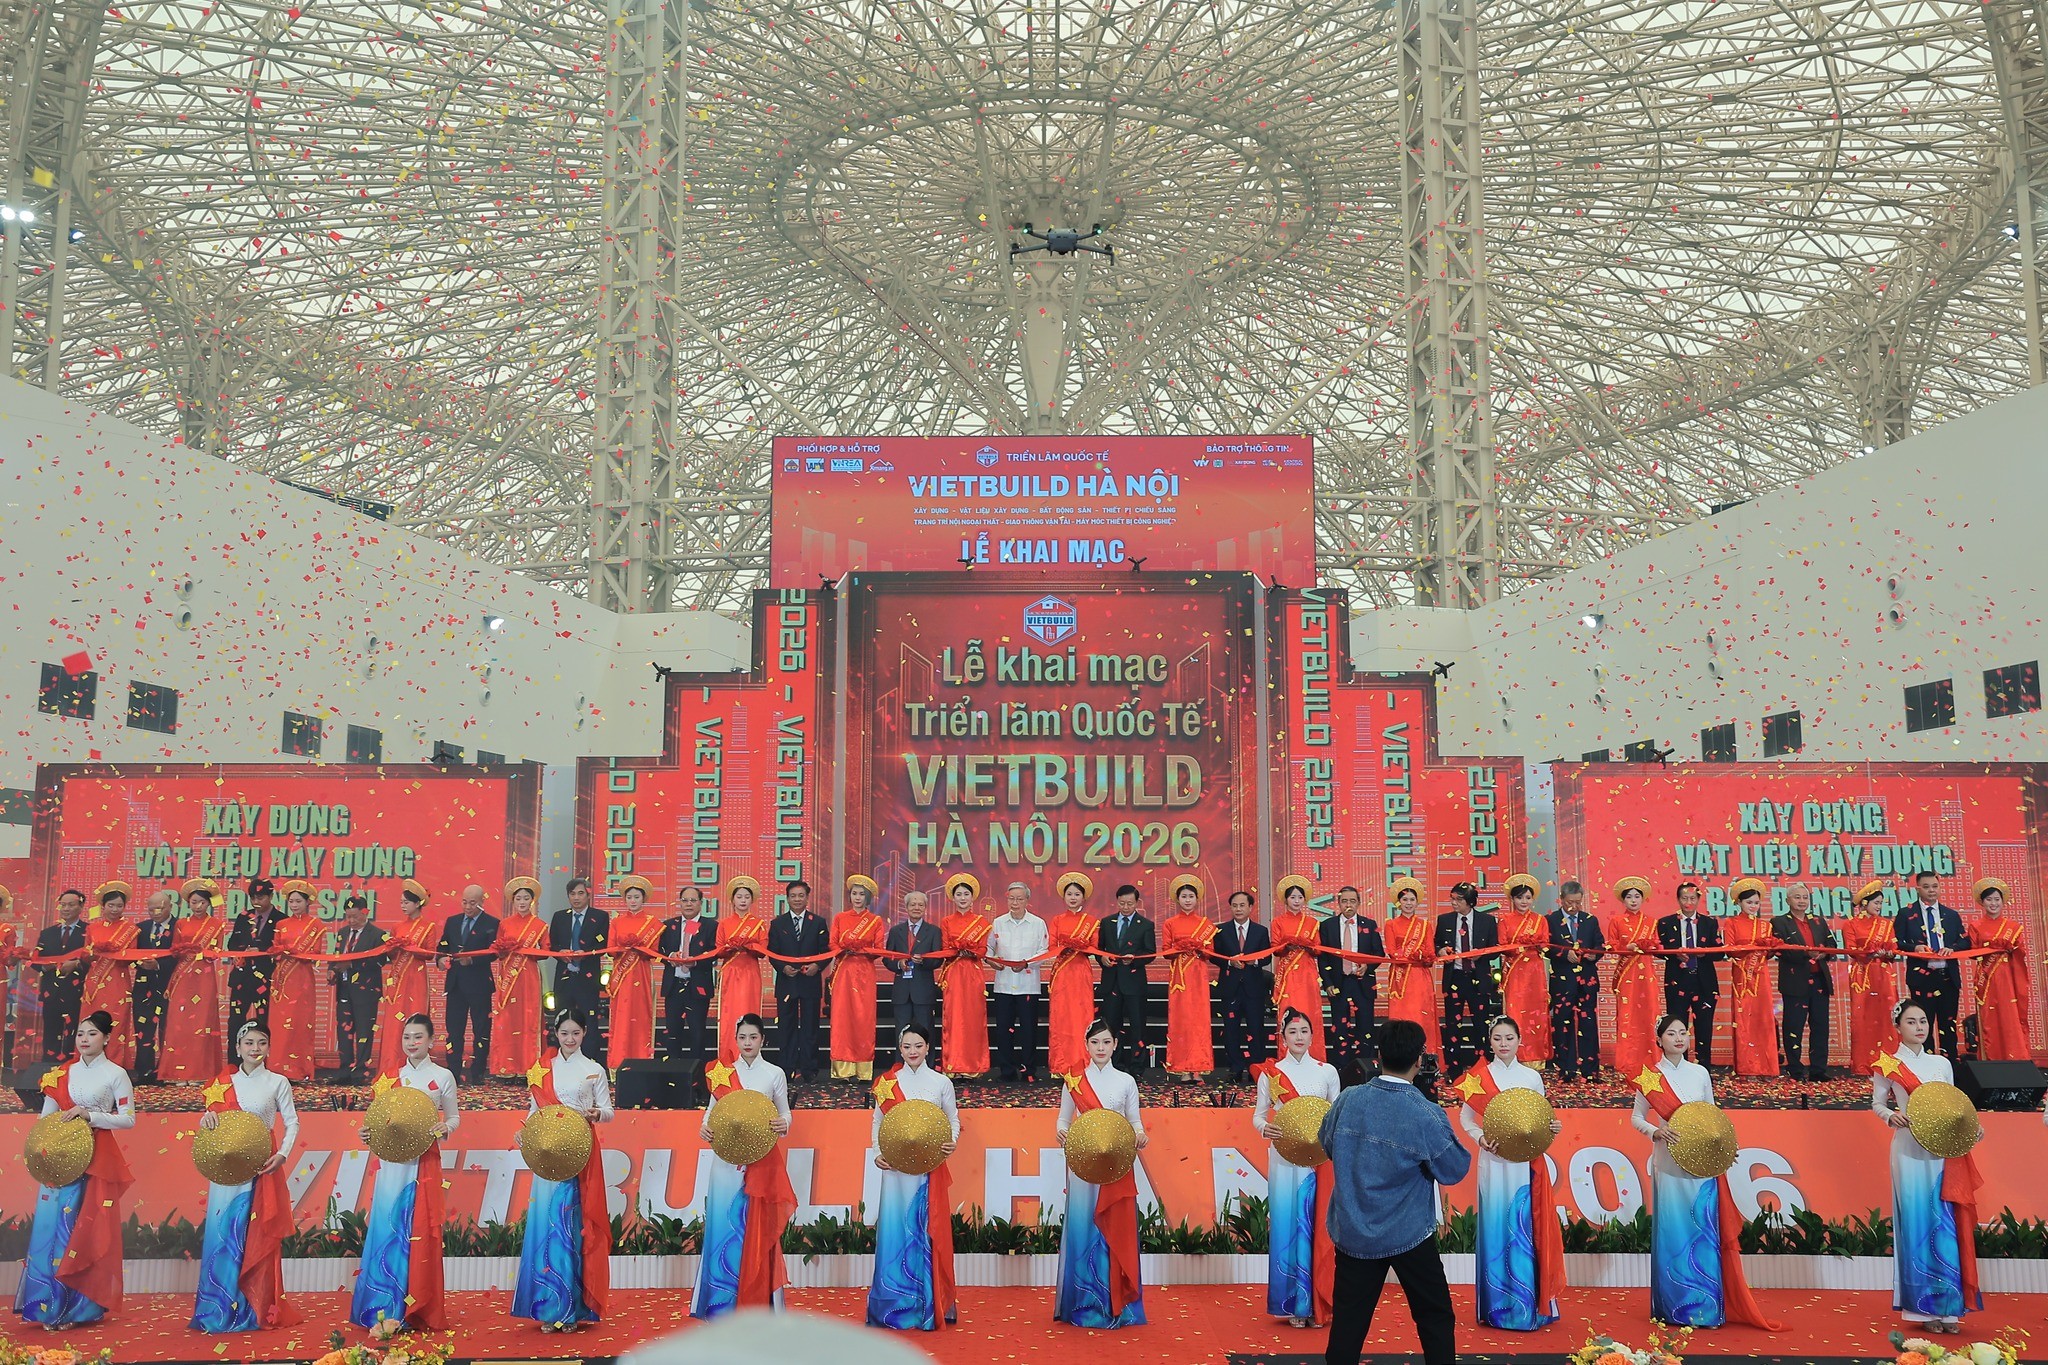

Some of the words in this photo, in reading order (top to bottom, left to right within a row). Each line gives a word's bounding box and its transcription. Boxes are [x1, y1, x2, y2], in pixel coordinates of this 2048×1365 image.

[797, 443, 818, 452] PHỐI
[820, 444, 838, 454] HỢP
[862, 444, 880, 454] TRỢ
[1006, 449, 1036, 461] TRIỂN
[1038, 450, 1060, 461] LÃM
[1063, 449, 1094, 461] QUỐC
[1096, 449, 1110, 461] TẾ
[1206, 443, 1224, 452] BẢO
[1226, 445, 1243, 454] TRỢ
[908, 475, 1070, 498] VIETBUILD
[1077, 468, 1120, 497] HÀ
[1126, 468, 1179, 504] NỘI
[961, 532, 990, 564] LỄ
[1000, 539, 1058, 564] KHAI
[1068, 539, 1125, 568] MẠC
[1027, 616, 1074, 624] VIETBUILD
[942, 639, 985, 682] Lễ
[997, 646, 1076, 682] khai
[1089, 653, 1168, 690] mạc
[1301, 588, 1330, 744] VIETBUILD
[905, 695, 989, 736] Triển
[1001, 702, 1061, 736] lãm
[1072, 698, 1155, 740] Quốc
[1163, 698, 1205, 736] Tế
[692, 716, 723, 884] VIETBUILD
[774, 716, 804, 882] VIETBUILD
[903, 754, 1202, 807] VIETBUILD
[204, 799, 261, 834] XÂY
[268, 800, 349, 840] DỰNG
[1468, 766, 1496, 856] 2026
[1738, 797, 1794, 832] XÂY
[1802, 798, 1883, 838] DỰNG
[135, 841, 193, 883] VẬT
[202, 841, 260, 883] LIỆU
[268, 841, 325, 877] XÂY
[333, 842, 414, 884] DỰNG
[908, 812, 973, 864] HÀ
[989, 812, 1068, 873] NỘI
[1083, 821, 1200, 864] 2026
[1675, 839, 1731, 879] VẬT
[1740, 839, 1800, 879] LIỆU
[1808, 840, 1864, 874] XÂY
[1872, 840, 1954, 880] DỰNG
